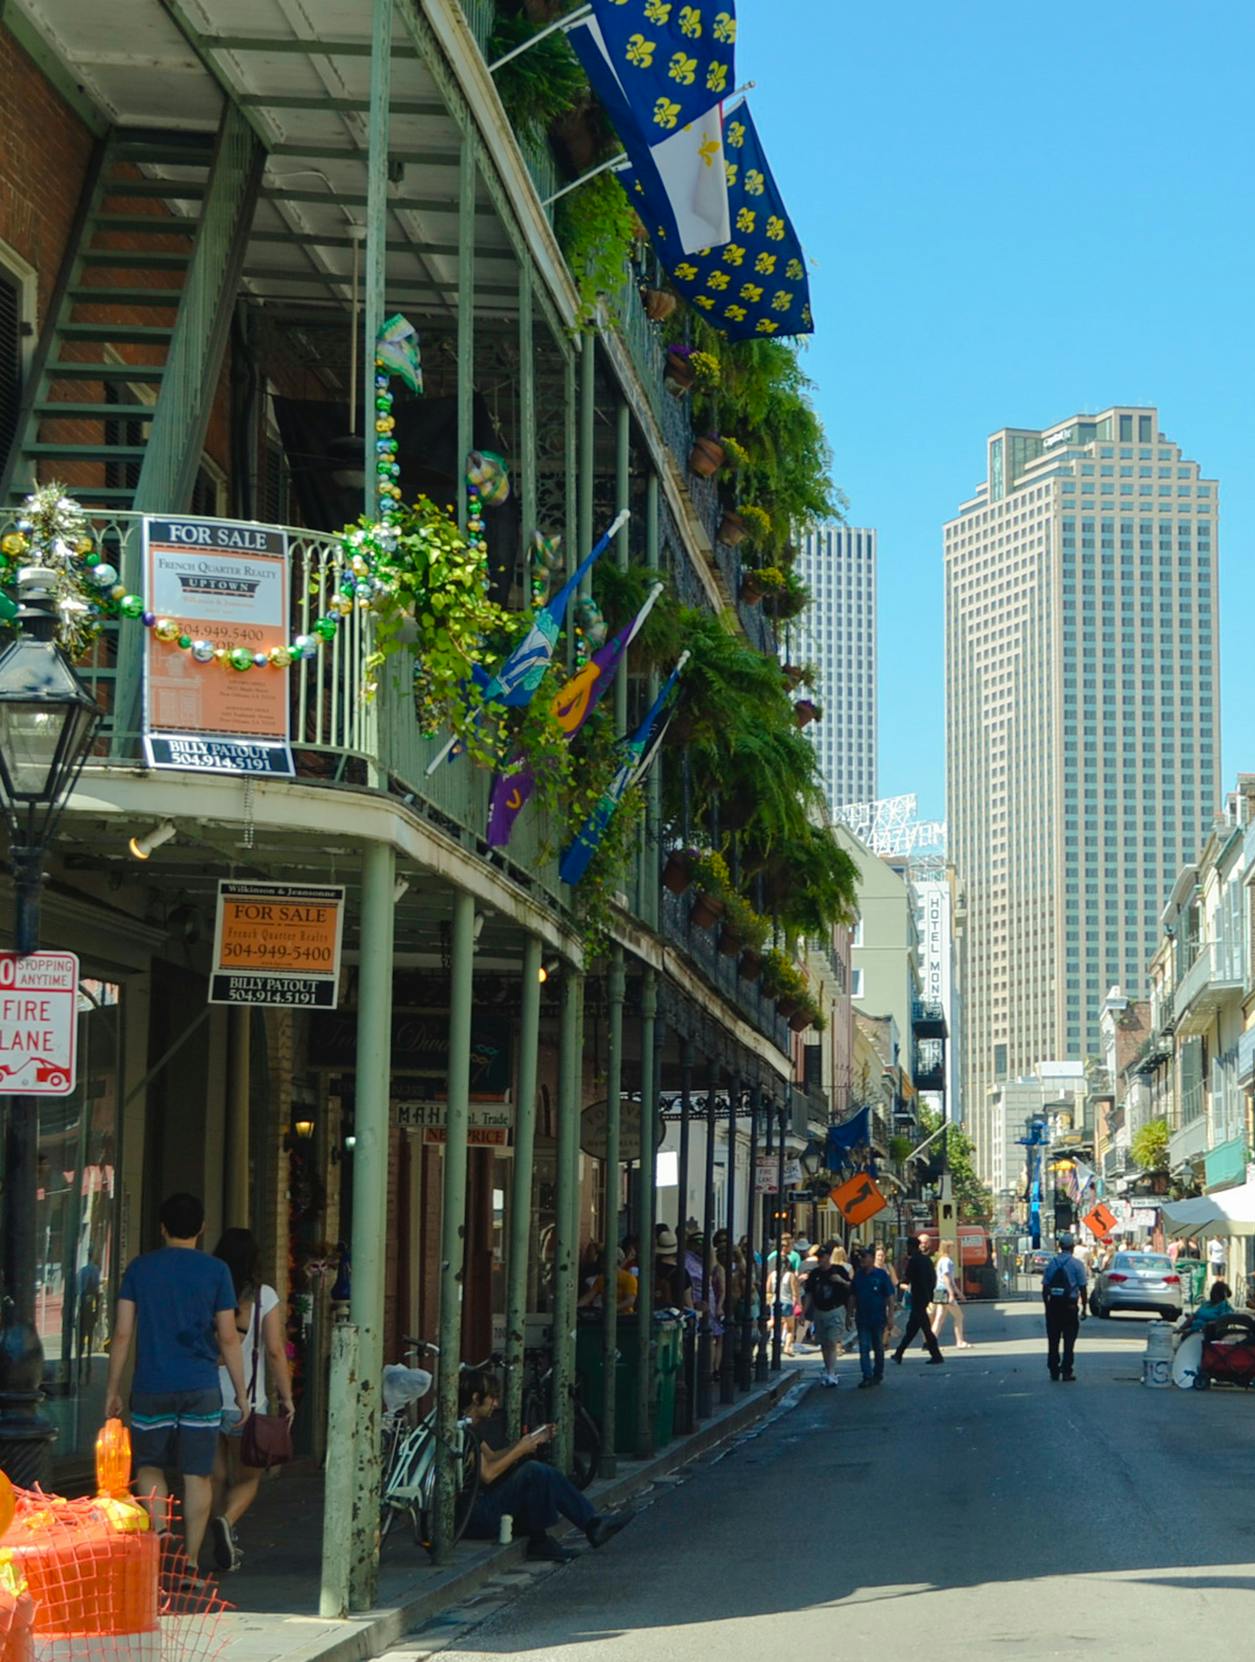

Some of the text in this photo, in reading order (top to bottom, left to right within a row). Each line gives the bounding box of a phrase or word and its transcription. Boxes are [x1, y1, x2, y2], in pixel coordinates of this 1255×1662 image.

[169, 524, 267, 549] FOR SALE
[158, 558, 277, 579] FRENCH QUARTER REALTY
[189, 578, 249, 592] UPTOWN
[178, 623, 264, 641] 504.949.5400
[168, 740, 270, 759] BILLY PATOUT
[171, 753, 272, 771] 504.914.5191
[234, 905, 327, 923] FOR SALE
[228, 927, 257, 939] French
[929, 898, 941, 953] HOTEL
[223, 943, 331, 961] 504-949-5400
[18, 959, 72, 972] STOPPING
[20, 974, 67, 987] ANYTIME
[229, 977, 319, 992] BILLY PATOUT
[229, 989, 316, 1004] 504.914.5191
[3, 999, 51, 1022] FIRE
[0, 1029, 54, 1052] LANE
